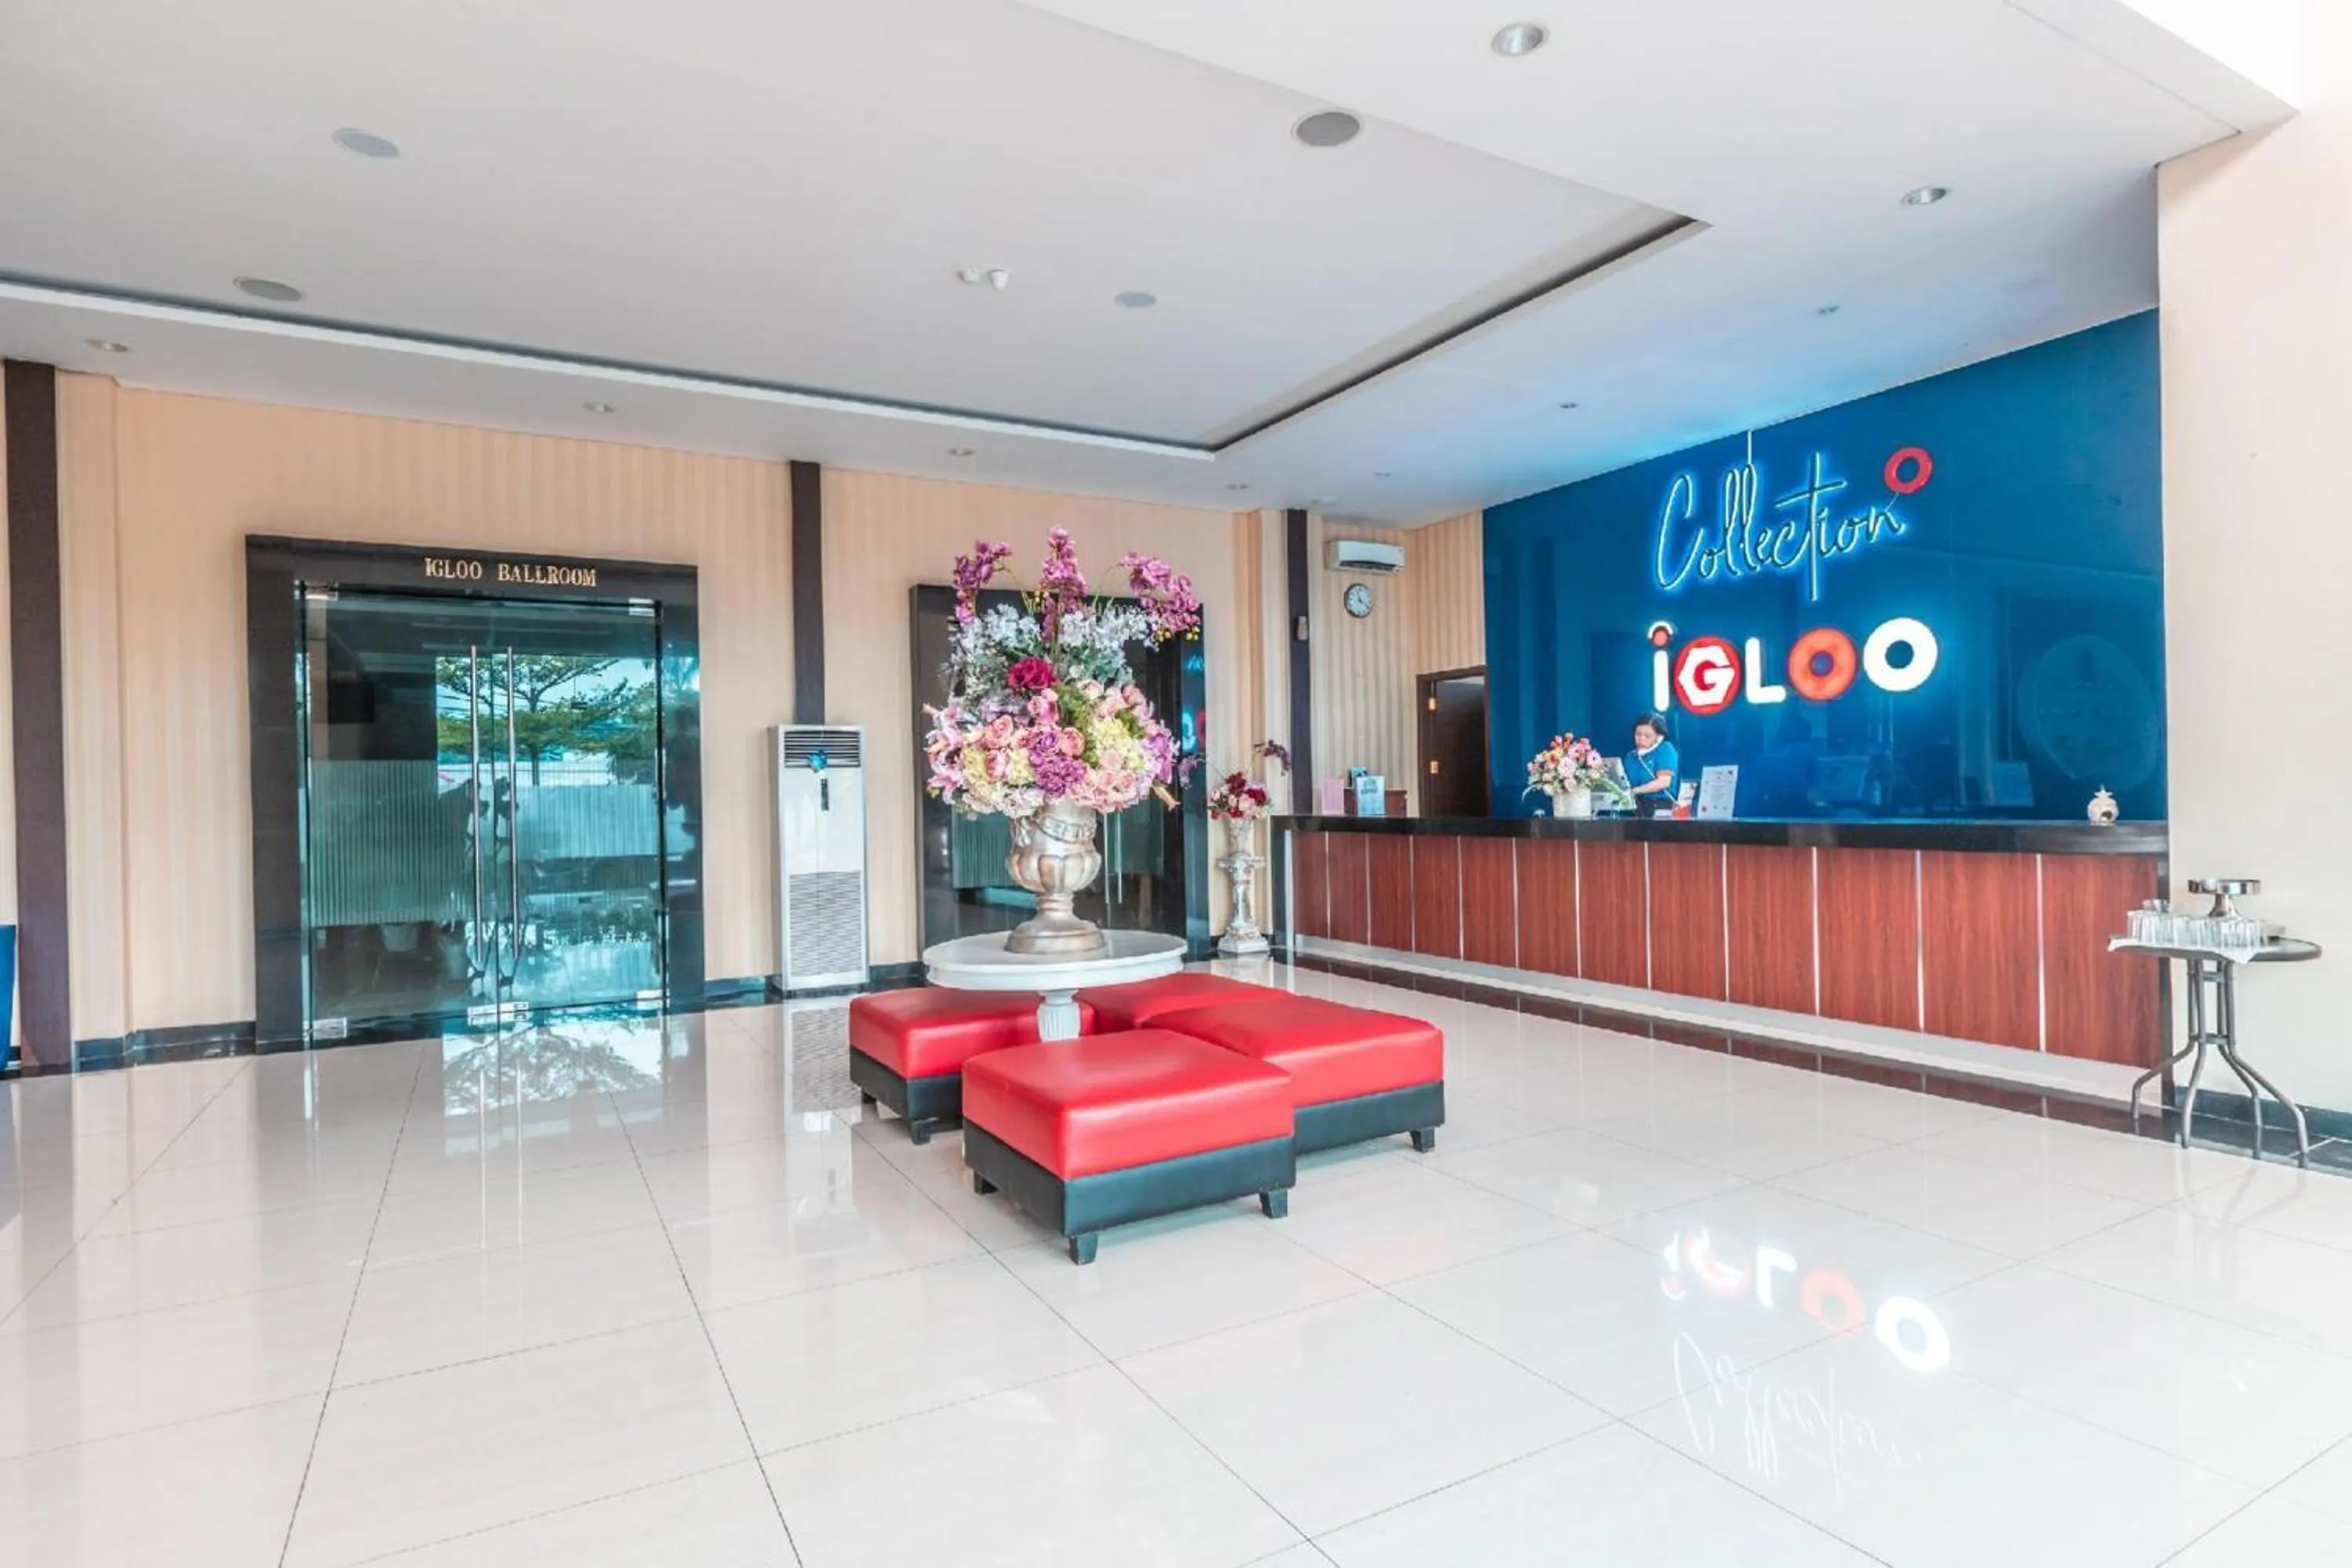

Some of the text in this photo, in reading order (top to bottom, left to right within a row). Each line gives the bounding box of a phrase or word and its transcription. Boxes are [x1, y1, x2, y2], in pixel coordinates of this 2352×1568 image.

[1657, 452, 1907, 601] Collection
[424, 557, 597, 586] IGLOO BALLROOM
